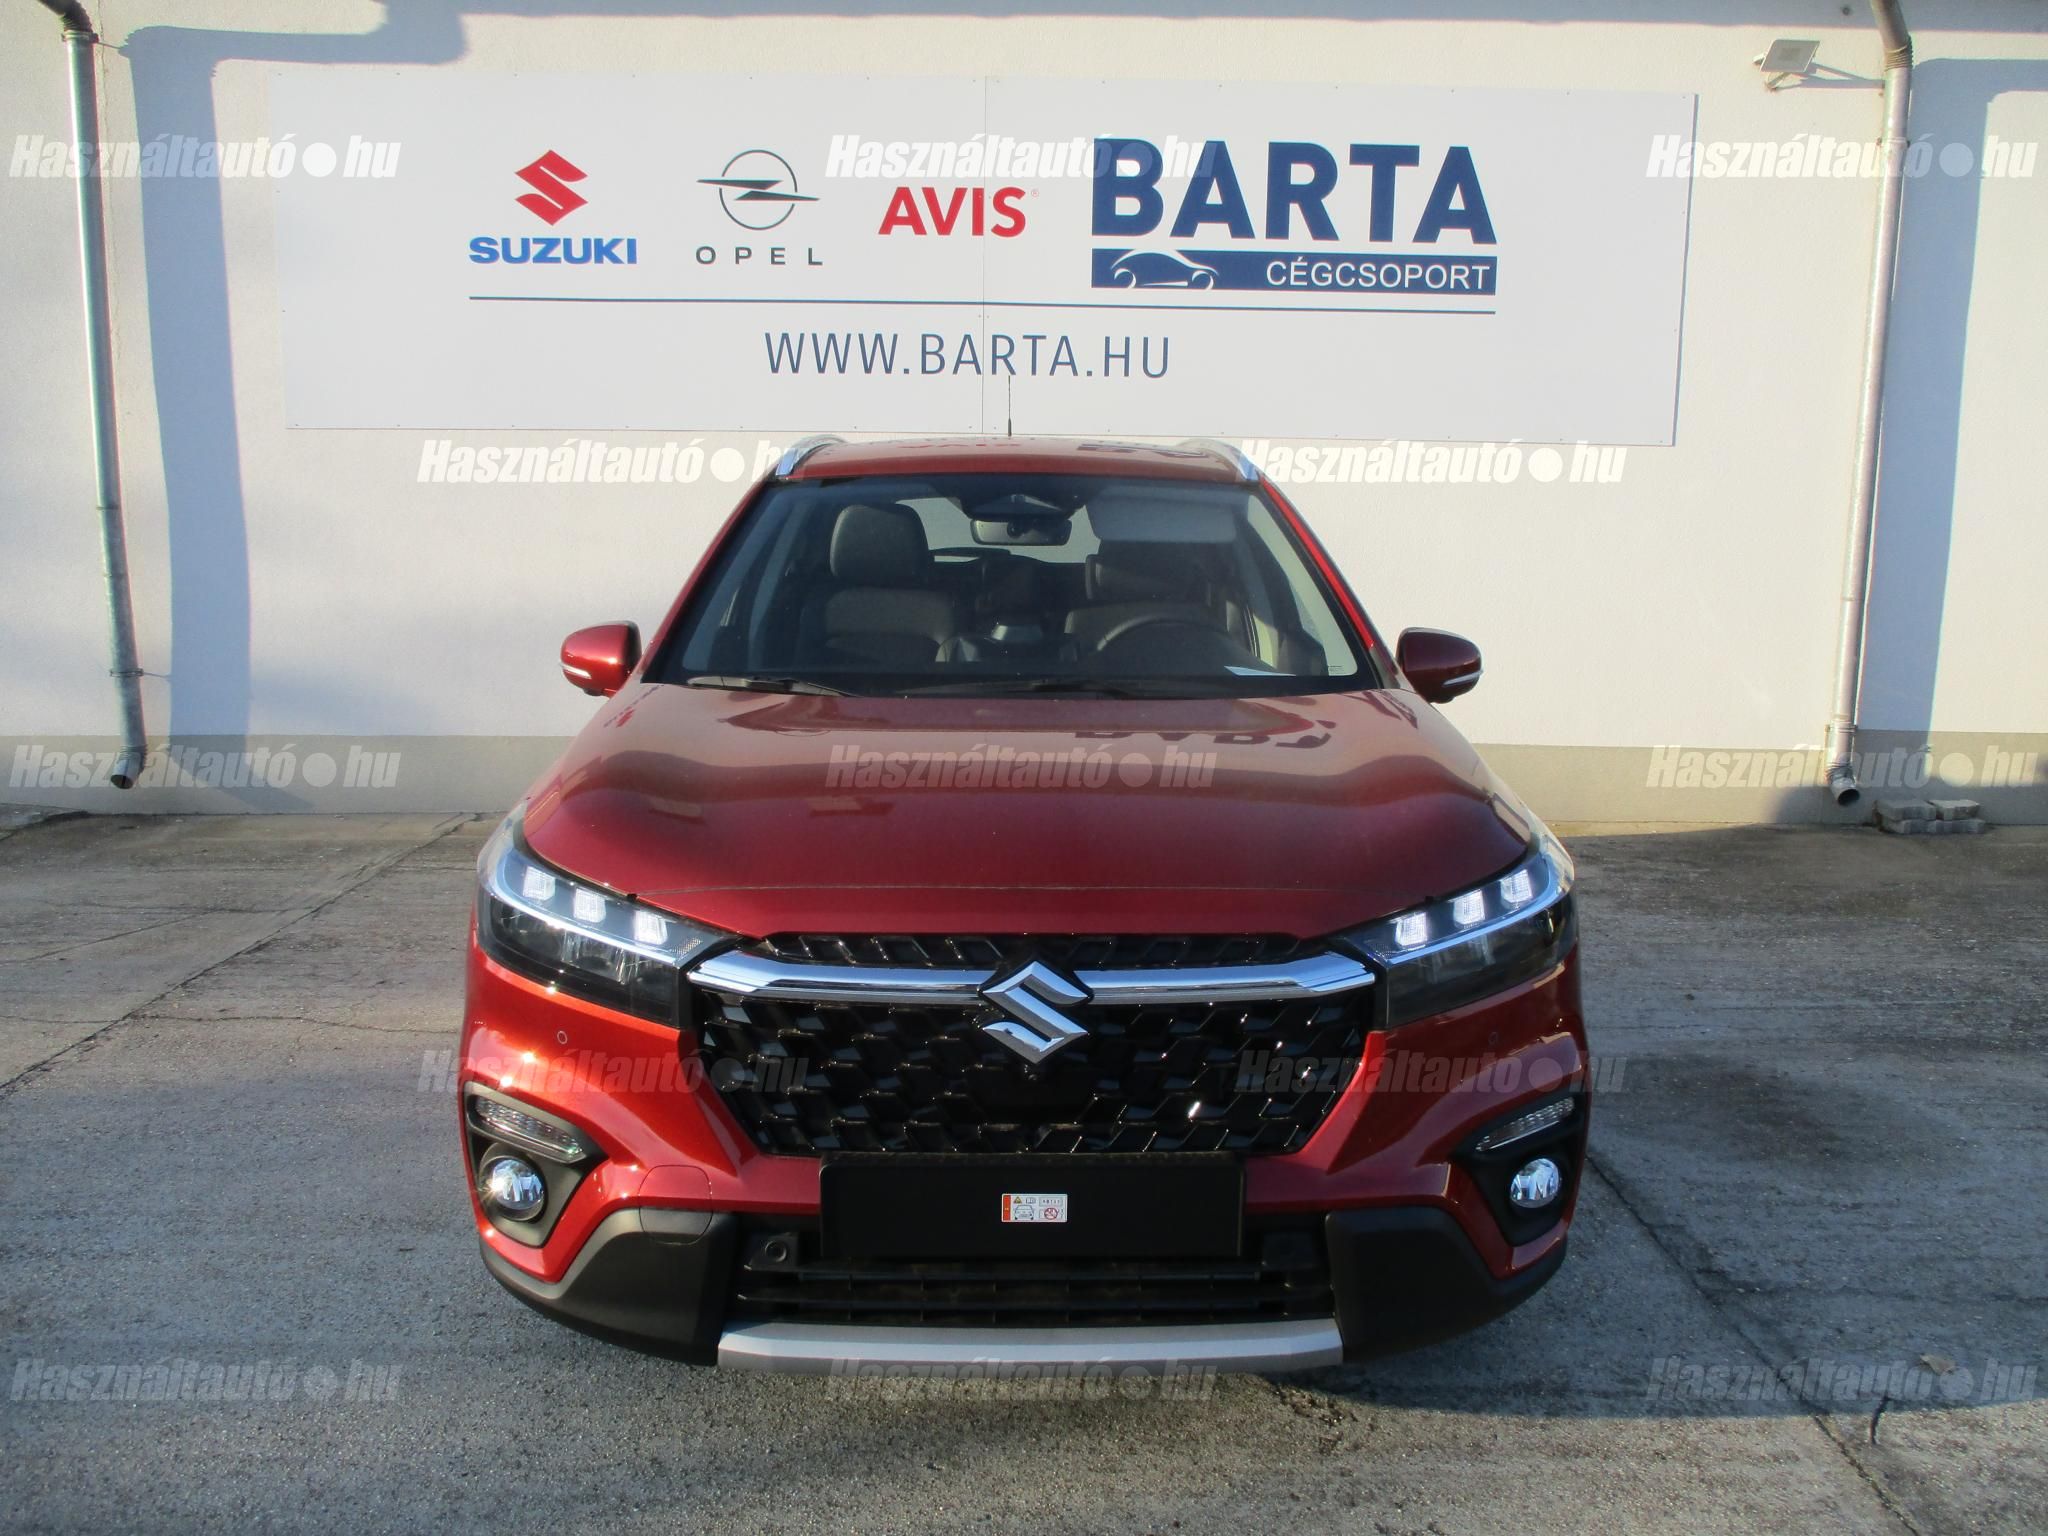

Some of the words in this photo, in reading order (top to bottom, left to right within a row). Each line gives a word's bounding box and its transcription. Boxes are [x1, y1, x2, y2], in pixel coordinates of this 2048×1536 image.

[1092, 138, 1497, 244] BARTA
[879, 187, 1026, 238] AVIS
[469, 237, 637, 264] SUZUKI
[695, 246, 823, 266] OPEL
[1266, 256, 1491, 291] CÉGCSOPORT
[765, 332, 1169, 380] WWW.BARTA.HU
